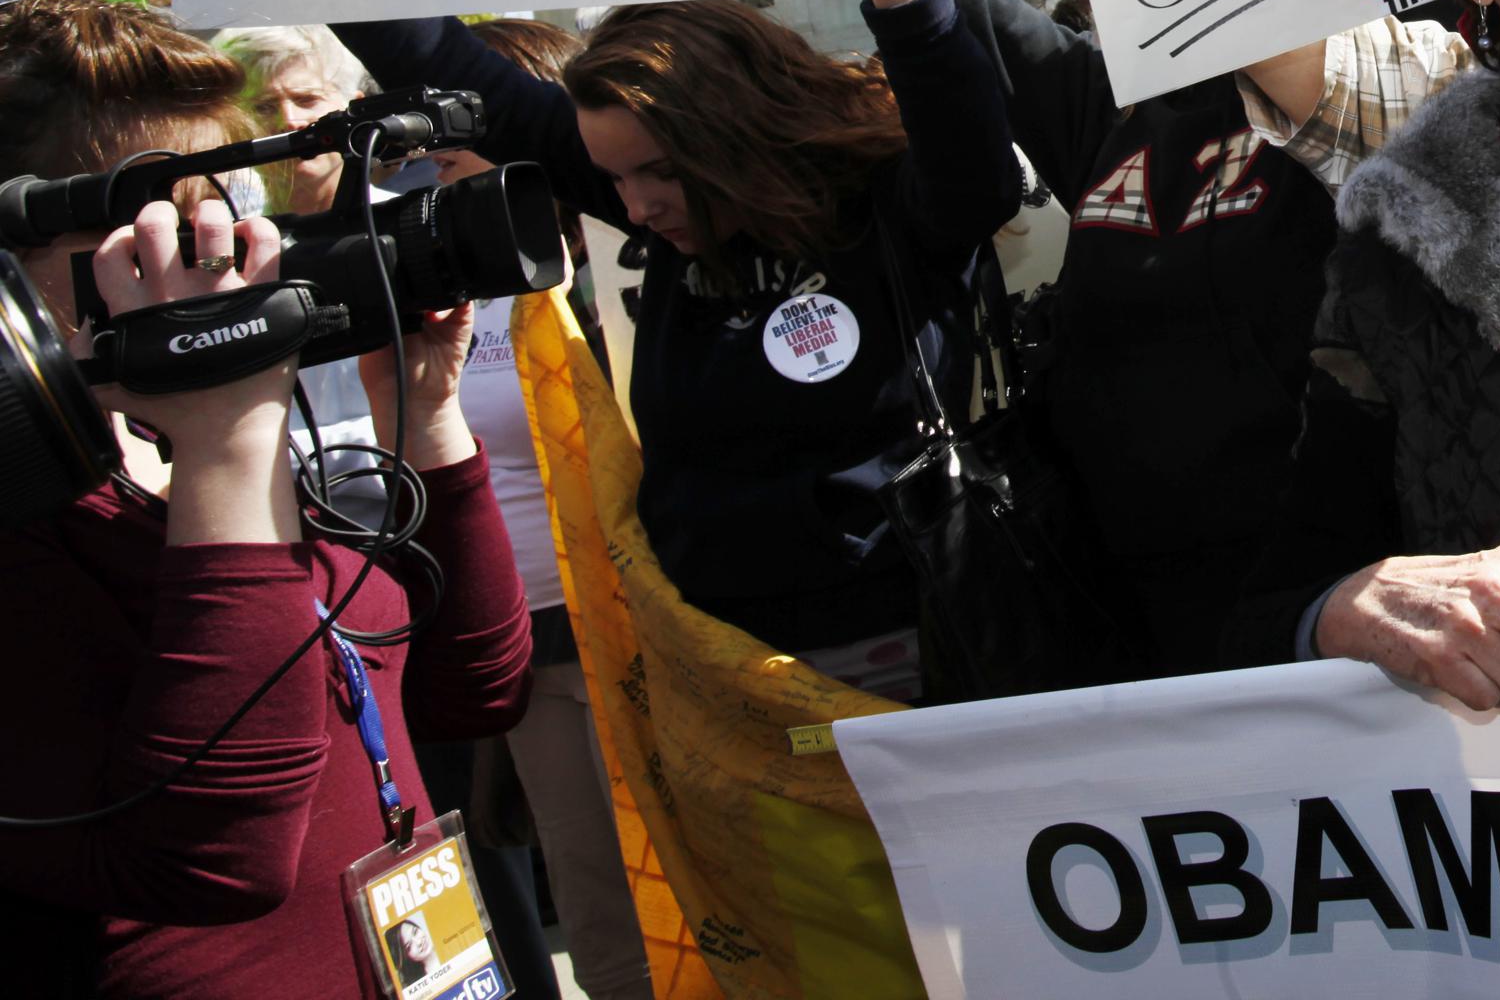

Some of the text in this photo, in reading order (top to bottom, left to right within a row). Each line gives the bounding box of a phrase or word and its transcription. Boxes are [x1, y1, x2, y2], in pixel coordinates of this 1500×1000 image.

[772, 303, 839, 338] BELIEVE THE
[781, 296, 818, 321] DON'T
[168, 316, 269, 354] Canon
[784, 318, 836, 347] LIBERAL
[792, 330, 839, 358] MEDIA!
[371, 847, 461, 927] PRESS
